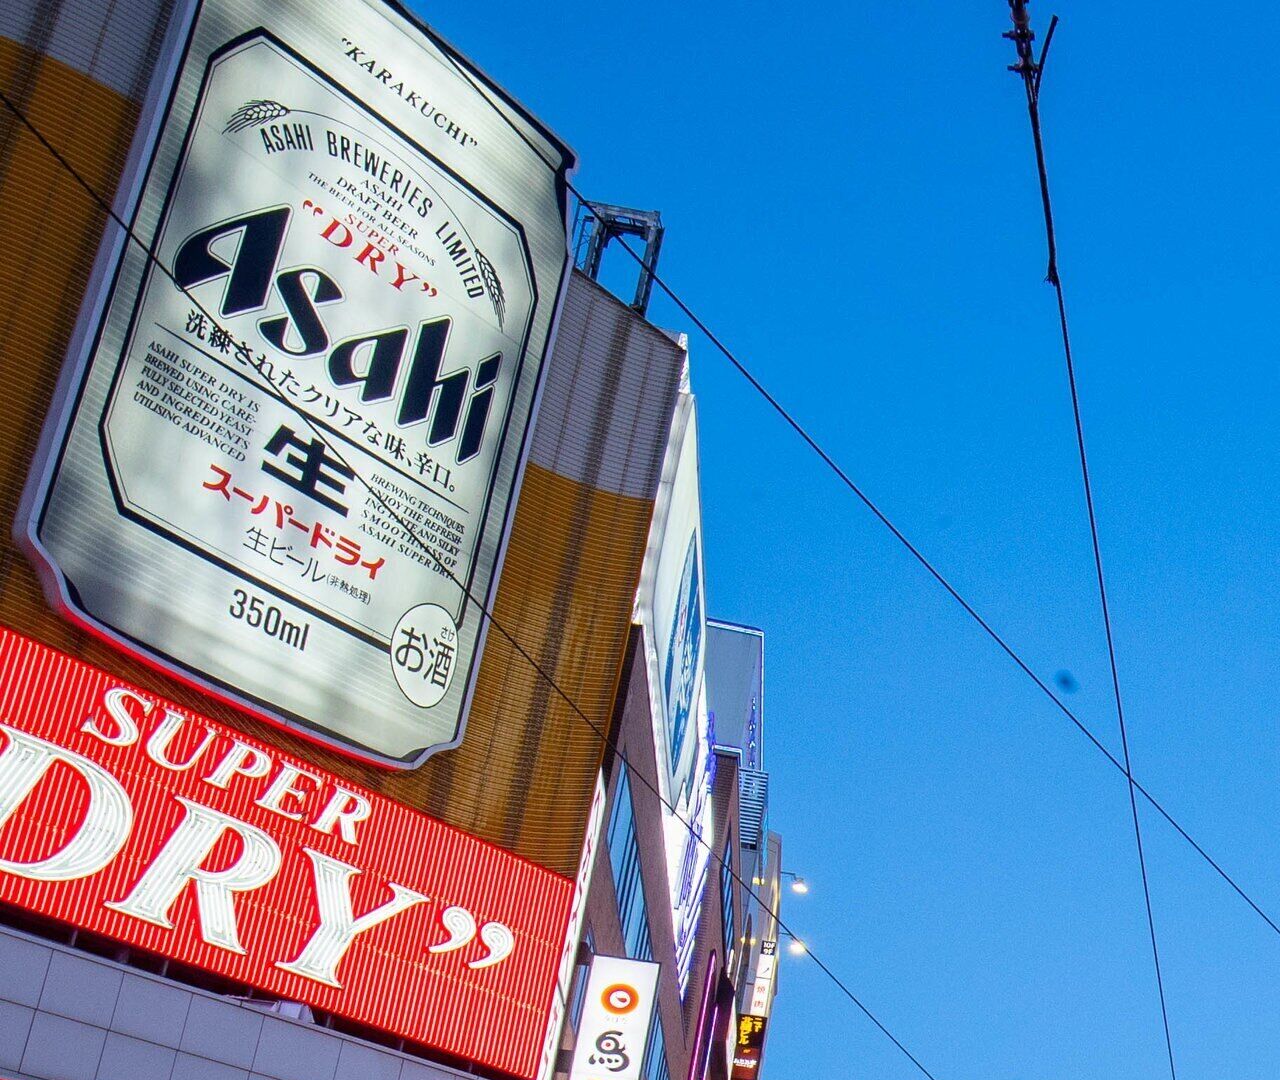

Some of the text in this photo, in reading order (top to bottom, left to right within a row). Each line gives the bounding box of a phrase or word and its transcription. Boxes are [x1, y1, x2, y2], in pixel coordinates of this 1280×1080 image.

[260, 123, 485, 299] ASAHI BREWERIES LIMITED
[336, 177, 419, 239] DRAFT BEER
[361, 179, 403, 211] ASAHI
[344, 214, 400, 256] SUPER
[174, 203, 502, 465] Asahi
[149, 341, 246, 405] ASAHI SUPER DRY
[168, 379, 219, 418] SELECTED
[185, 309, 455, 493] 洗練されたクリアな味、辛口。
[134, 392, 247, 462] UTILISING ADVANCED
[162, 391, 251, 450] INGREDIENTS
[261, 424, 355, 518] 生
[202, 463, 386, 580] スーパードライ
[417, 500, 465, 535] TECHNIQUES
[242, 525, 326, 586] 生ビール
[229, 588, 311, 652] 350ml
[394, 626, 455, 688] お酒
[81, 686, 370, 846] SUPER
